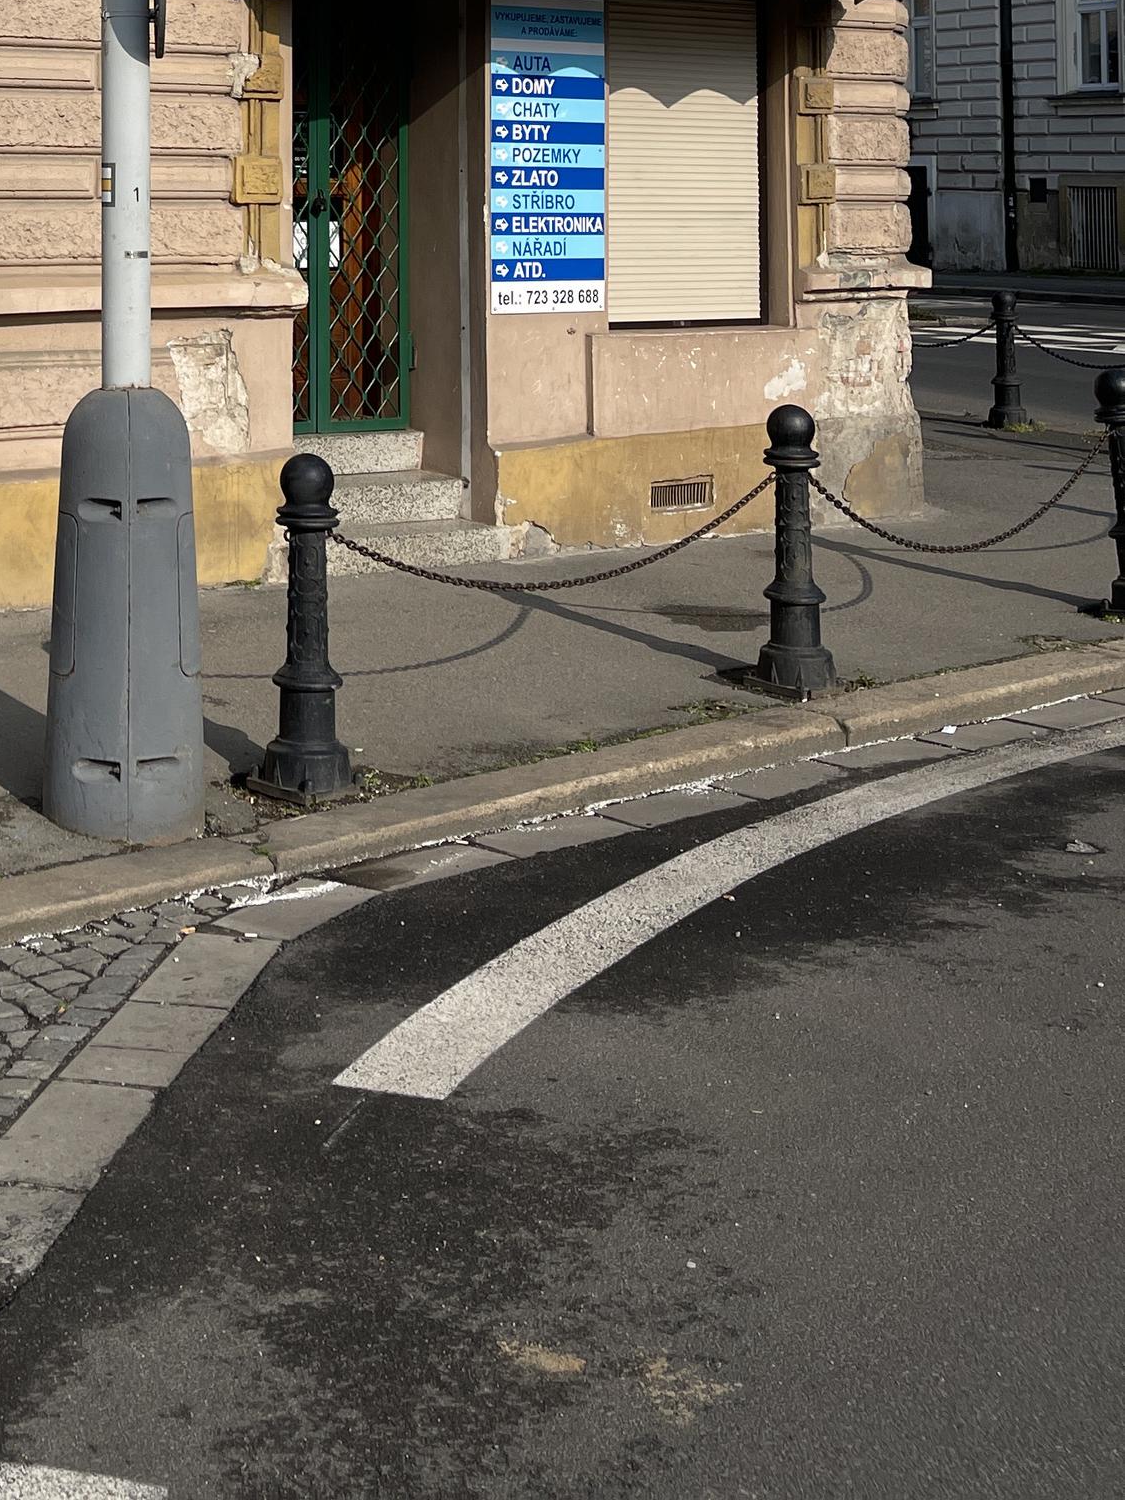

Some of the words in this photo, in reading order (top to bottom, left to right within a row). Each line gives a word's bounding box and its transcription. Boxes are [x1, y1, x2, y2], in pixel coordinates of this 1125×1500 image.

[550, 15, 602, 26] ZASTAVUJEME
[521, 26, 527, 35] A
[513, 55, 551, 72] AUTA
[512, 78, 555, 95] DOMY
[512, 102, 560, 118] CHATY
[512, 124, 551, 141] BYTY
[512, 147, 581, 164] POZEMKY
[511, 170, 559, 187] ZLATO
[133, 187, 140, 202] 1
[512, 191, 575, 210] STŘÍBRO
[512, 217, 603, 233] ELEKTRONIKA
[512, 238, 567, 257] NÁŘADÍ
[513, 262, 546, 278] ATD.
[498, 291, 522, 306] tel.:
[526, 290, 548, 305] 723
[552, 289, 574, 304] 328
[578, 289, 599, 304] 688
